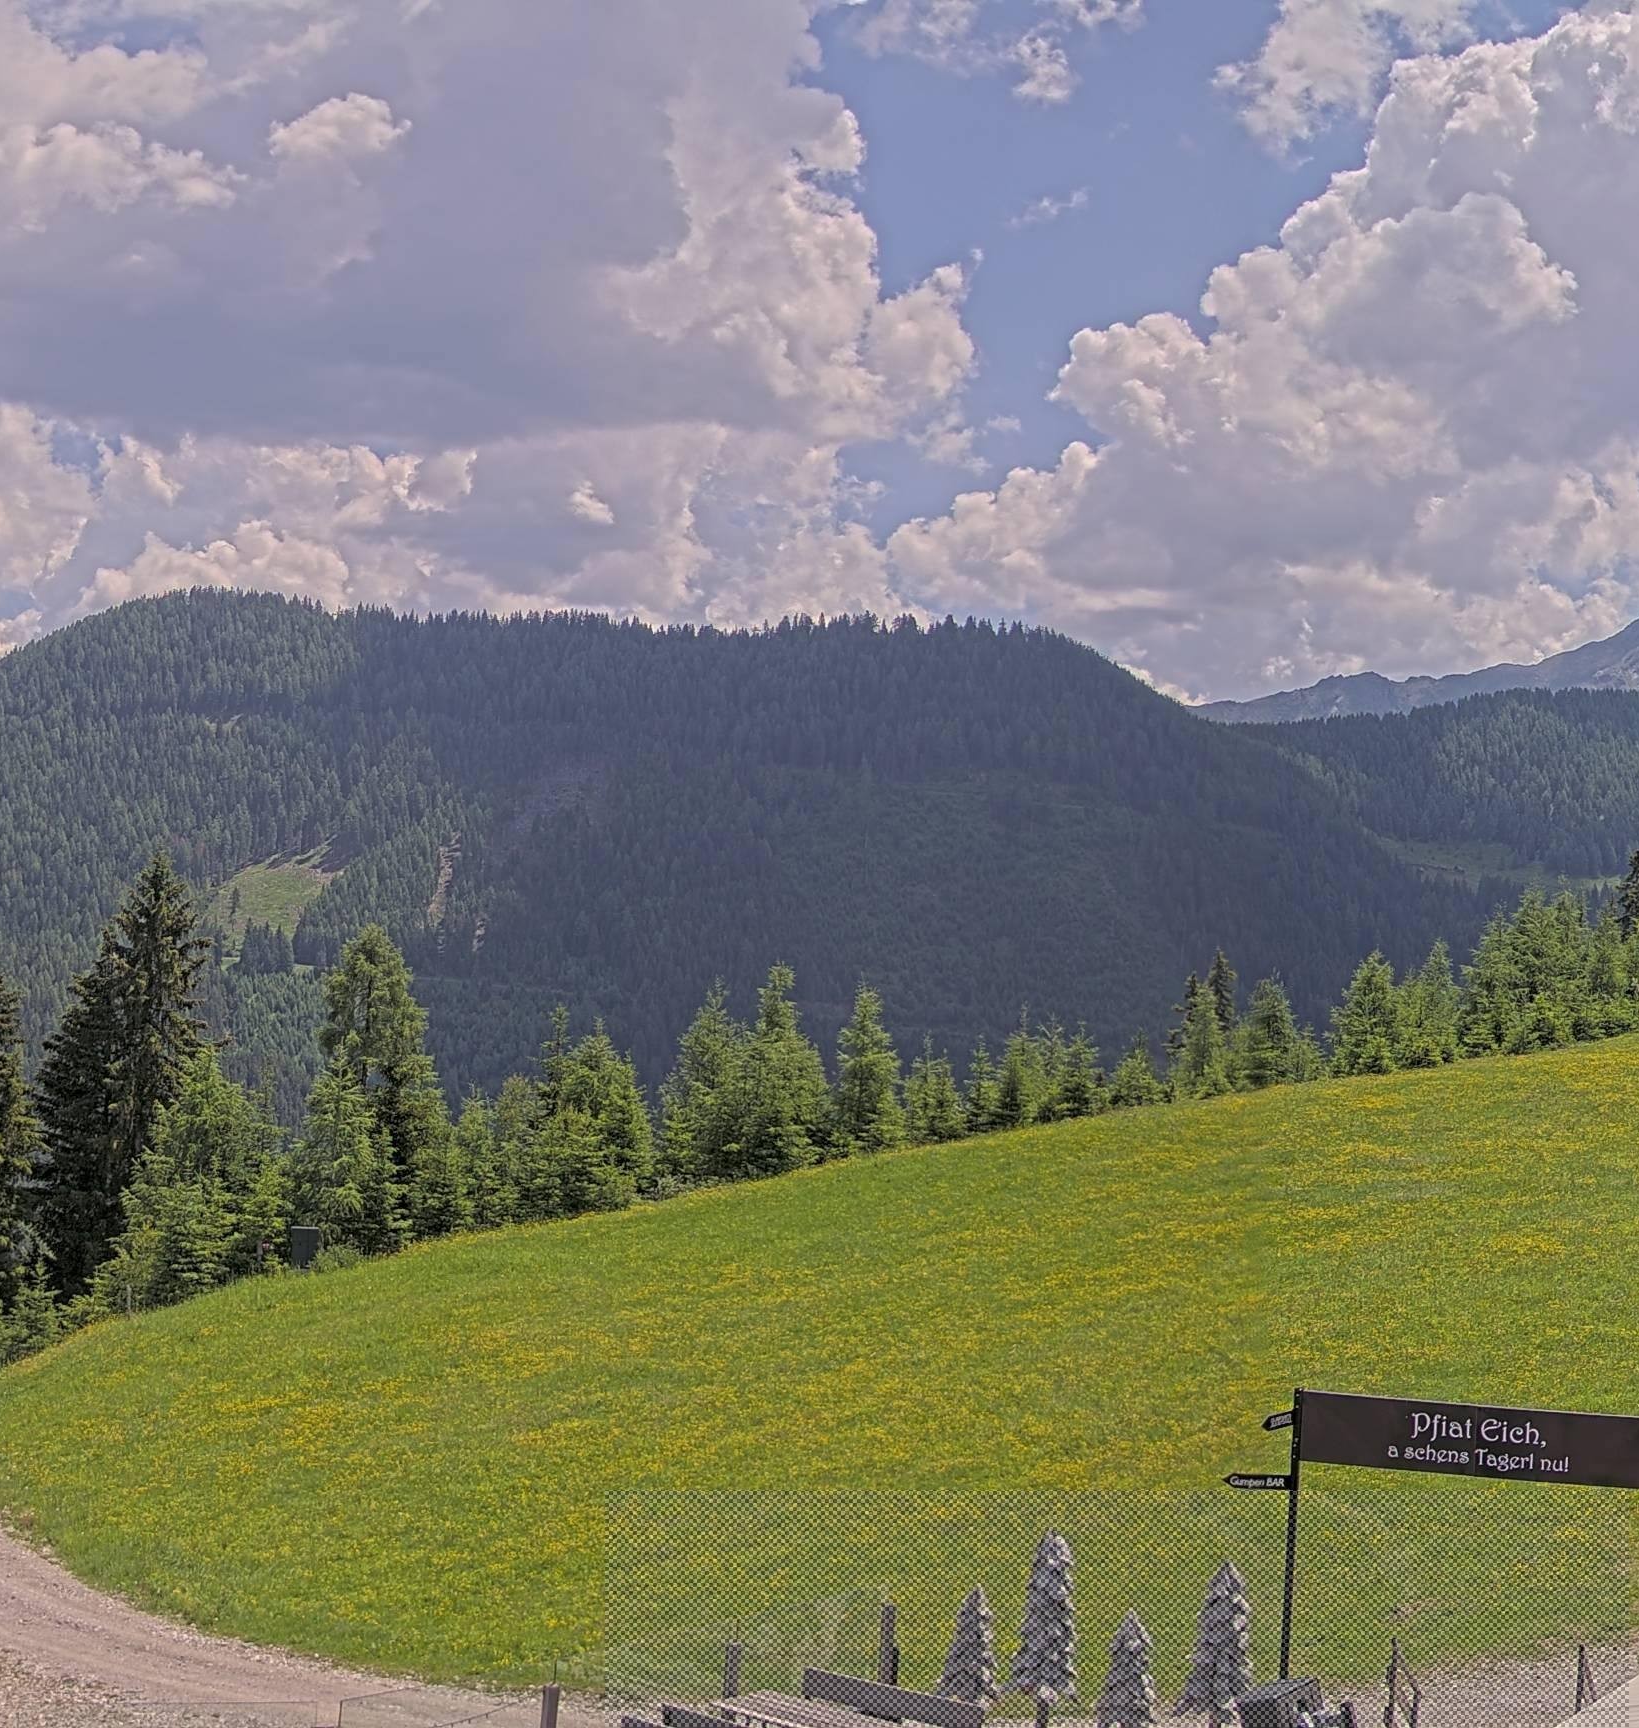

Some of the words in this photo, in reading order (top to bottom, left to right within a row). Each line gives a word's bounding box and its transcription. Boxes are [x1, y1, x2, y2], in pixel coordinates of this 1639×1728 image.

[1410, 1412, 1472, 1442] Pfiat
[1480, 1418, 1547, 1448] Eich,
[1387, 1444, 1399, 1458] a
[1404, 1444, 1470, 1464] schens
[1474, 1448, 1534, 1472] Tagerl
[1540, 1456, 1570, 1473] nu!
[1266, 1477, 1285, 1488] BAR
